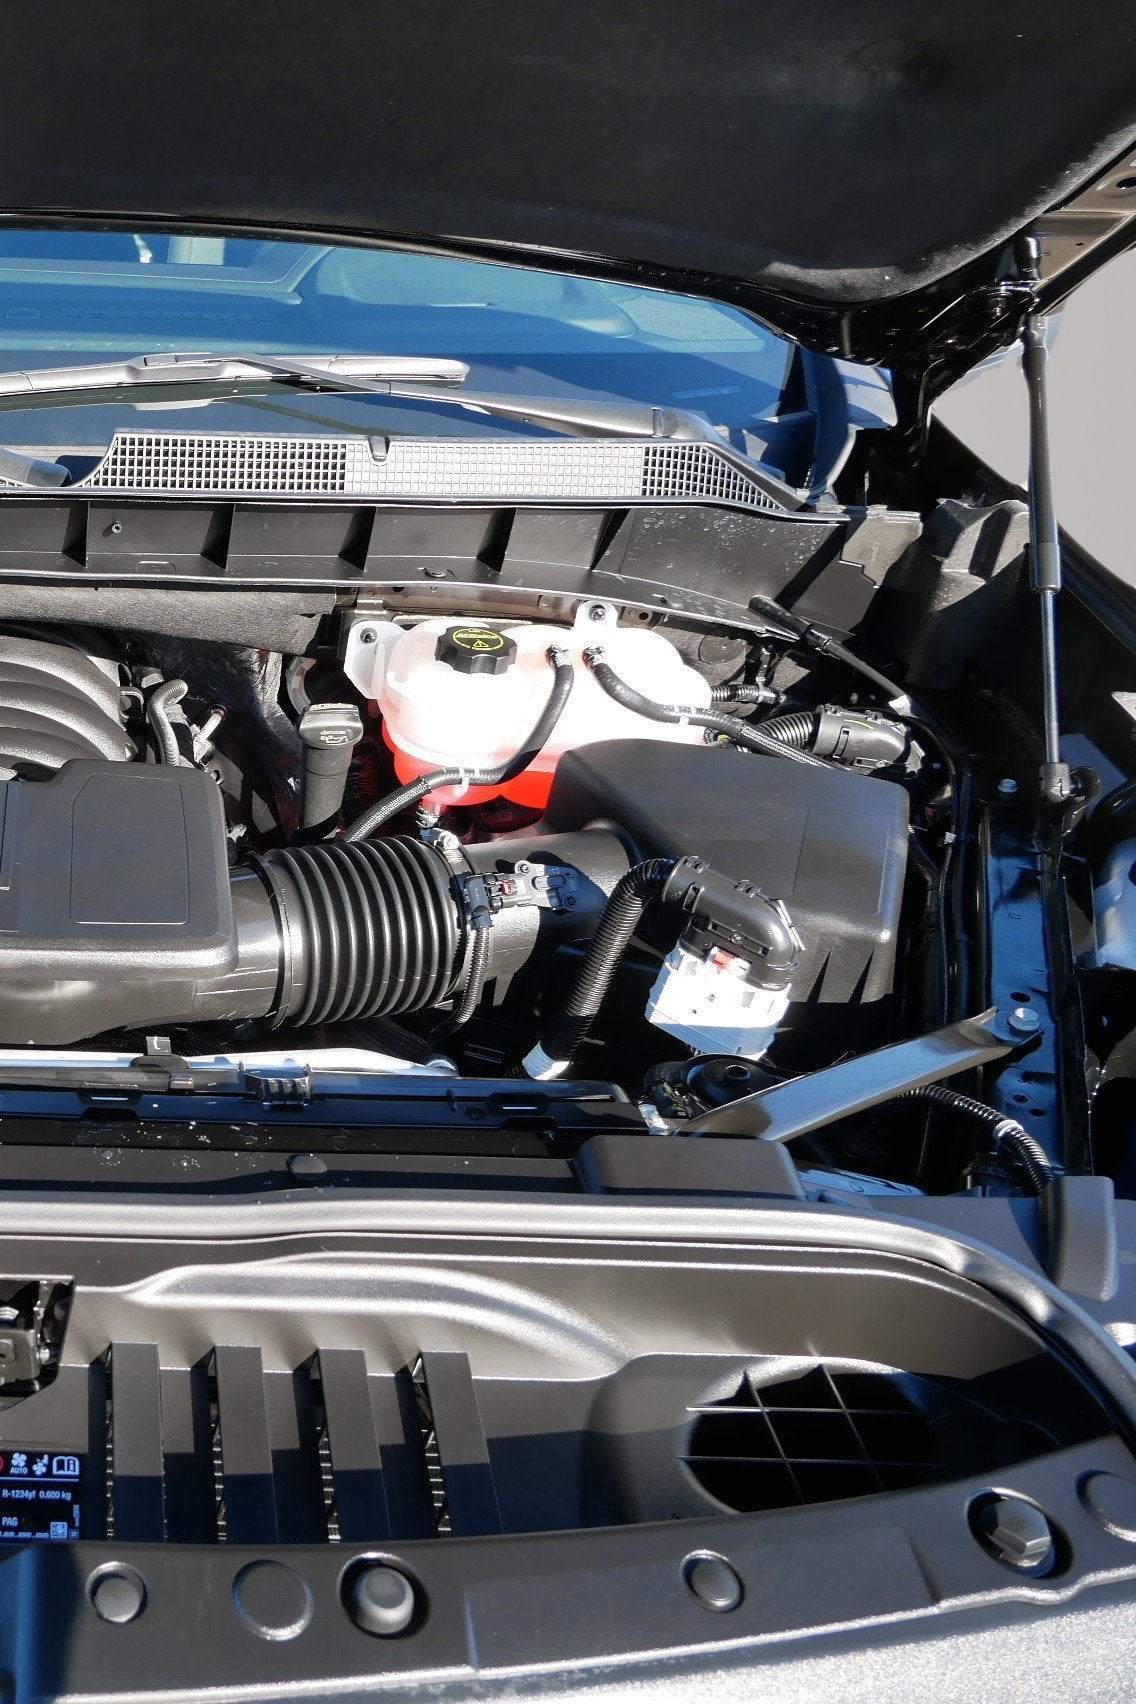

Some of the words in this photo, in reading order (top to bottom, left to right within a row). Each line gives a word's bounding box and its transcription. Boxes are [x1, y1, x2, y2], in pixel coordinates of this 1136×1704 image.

[2, 1489, 36, 1500] R-1234yf
[39, 1491, 60, 1499] 0.600
[62, 1491, 71, 1501] kg
[2, 1517, 18, 1526] PAG
